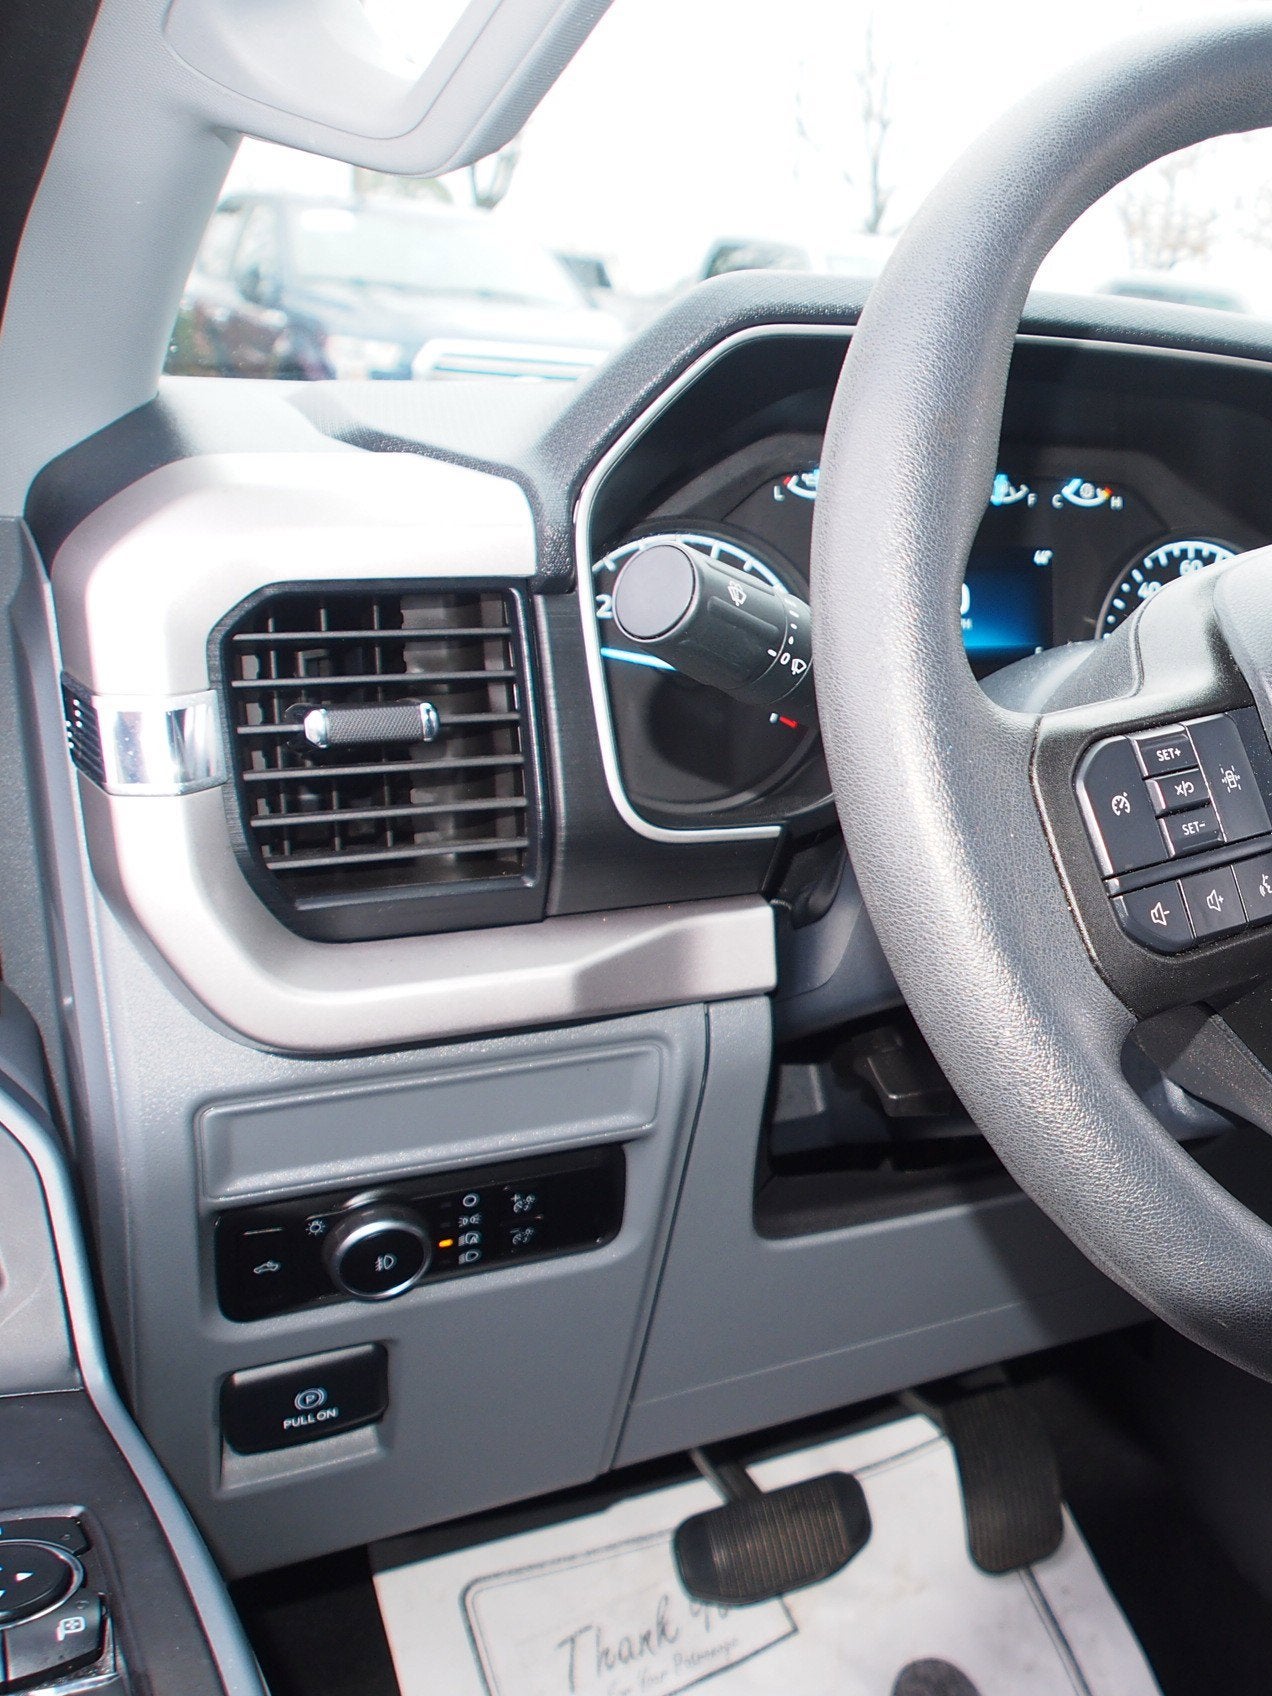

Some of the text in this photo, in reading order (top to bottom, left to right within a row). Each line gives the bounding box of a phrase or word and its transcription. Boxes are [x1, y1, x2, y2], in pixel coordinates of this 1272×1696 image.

[1156, 747, 1181, 761] SET+
[283, 1407, 338, 1430] PULL ON
[557, 1593, 680, 1696] Thank
